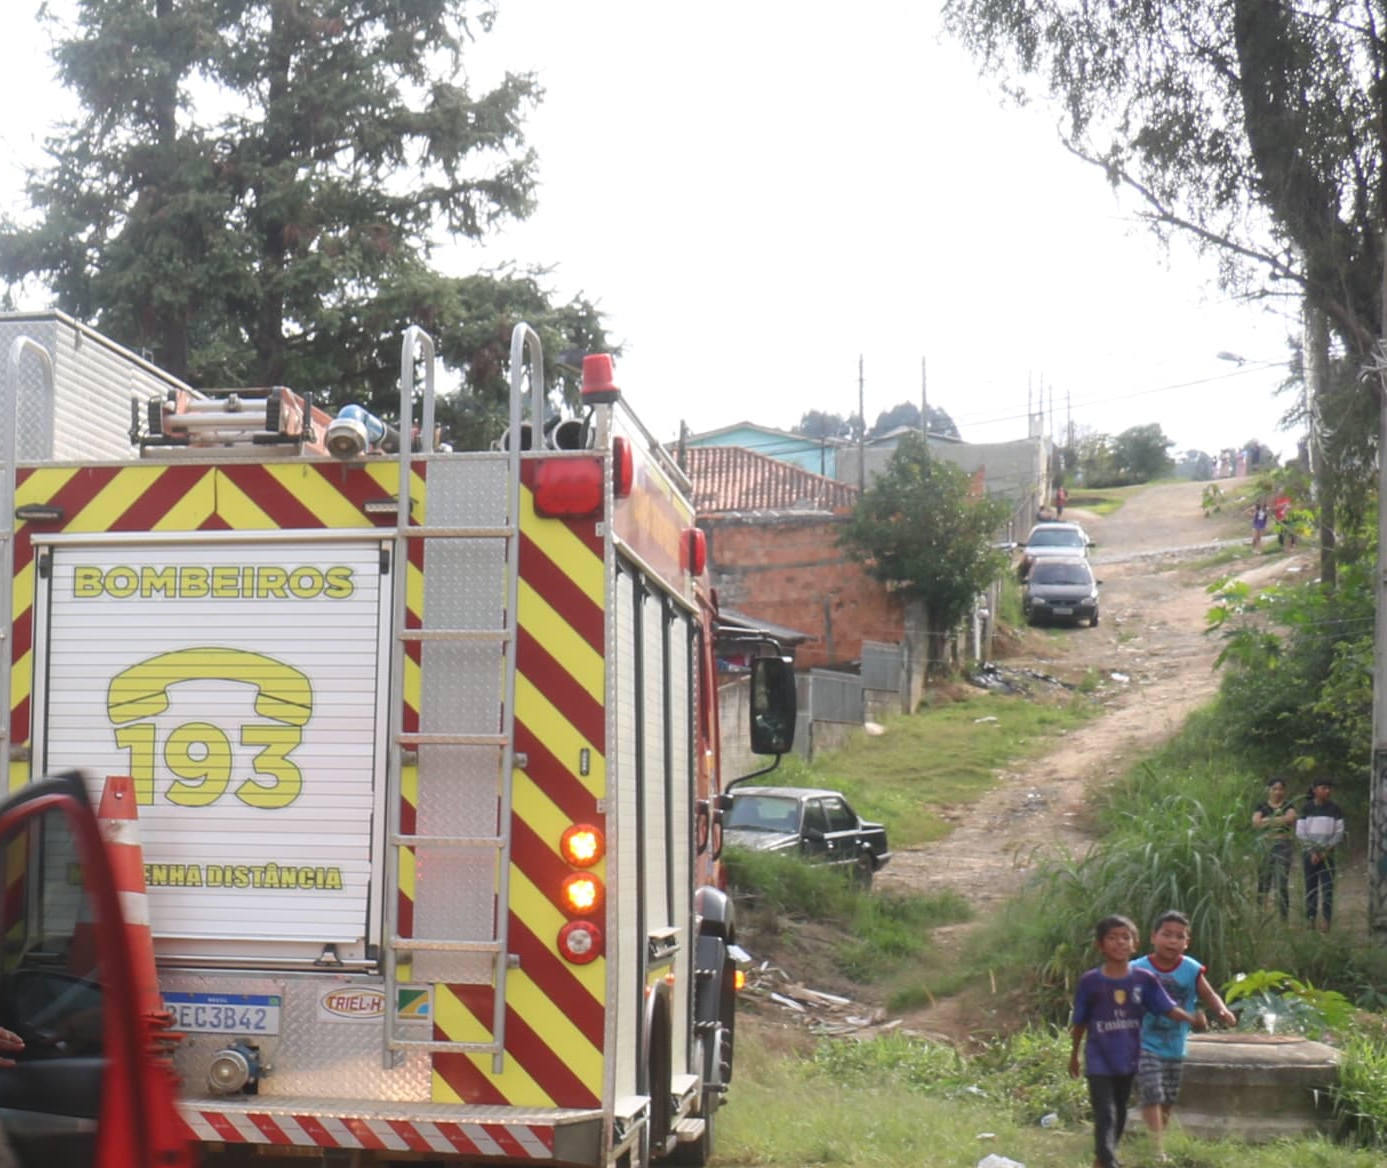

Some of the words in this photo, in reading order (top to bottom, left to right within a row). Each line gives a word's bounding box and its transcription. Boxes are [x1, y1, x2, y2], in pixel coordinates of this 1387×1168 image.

[73, 566, 355, 598] BOMBEIROS
[113, 722, 303, 810] 193
[206, 861, 343, 890] DISTÂNCIA
[328, 995, 385, 1012] TRIEL-H
